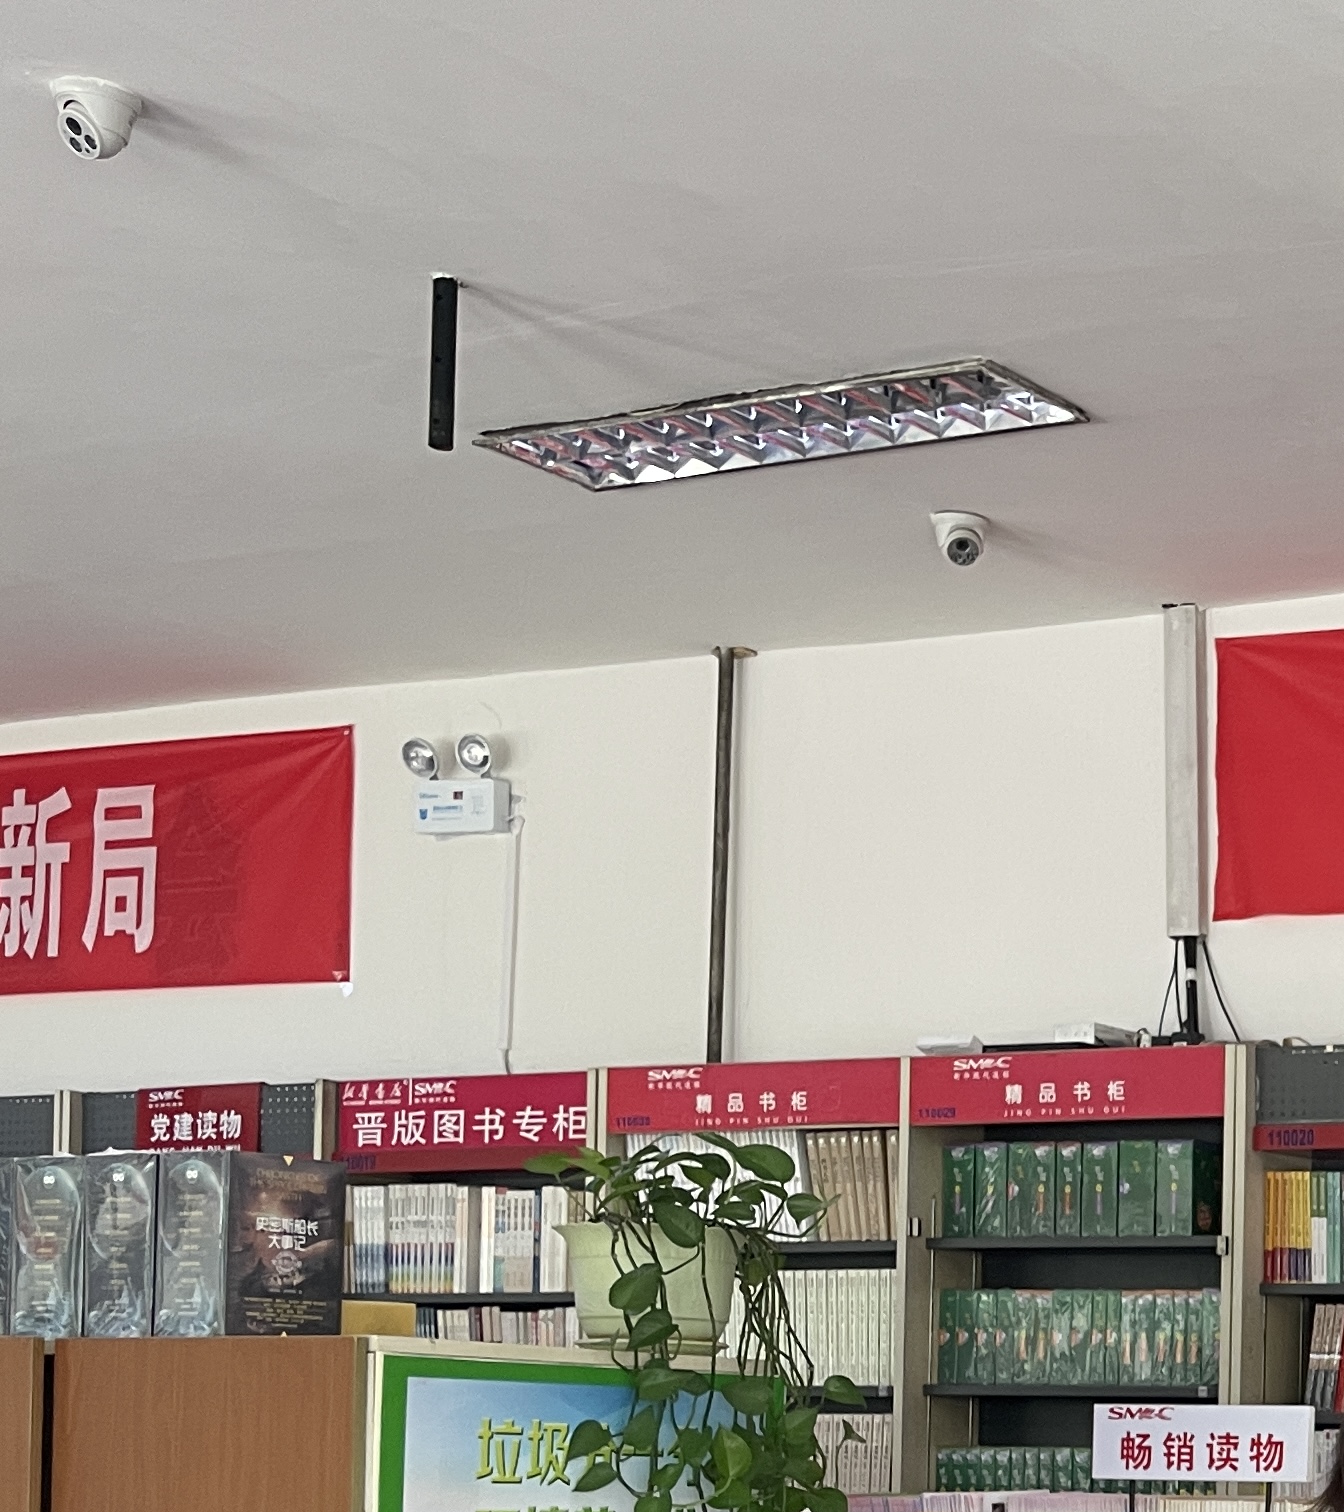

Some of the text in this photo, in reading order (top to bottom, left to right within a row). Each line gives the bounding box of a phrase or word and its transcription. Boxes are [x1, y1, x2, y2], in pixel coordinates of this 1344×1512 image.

[0, 784, 157, 959] 新局
[695, 1091, 808, 1114] 精品书柜
[1005, 1080, 1126, 1105] 精品书柜
[150, 1110, 242, 1142] 党建读物
[352, 1105, 588, 1147] 晋版图书专柜
[1266, 1128, 1316, 1147] 110020
[1120, 1431, 1285, 1473] 畅销读物
